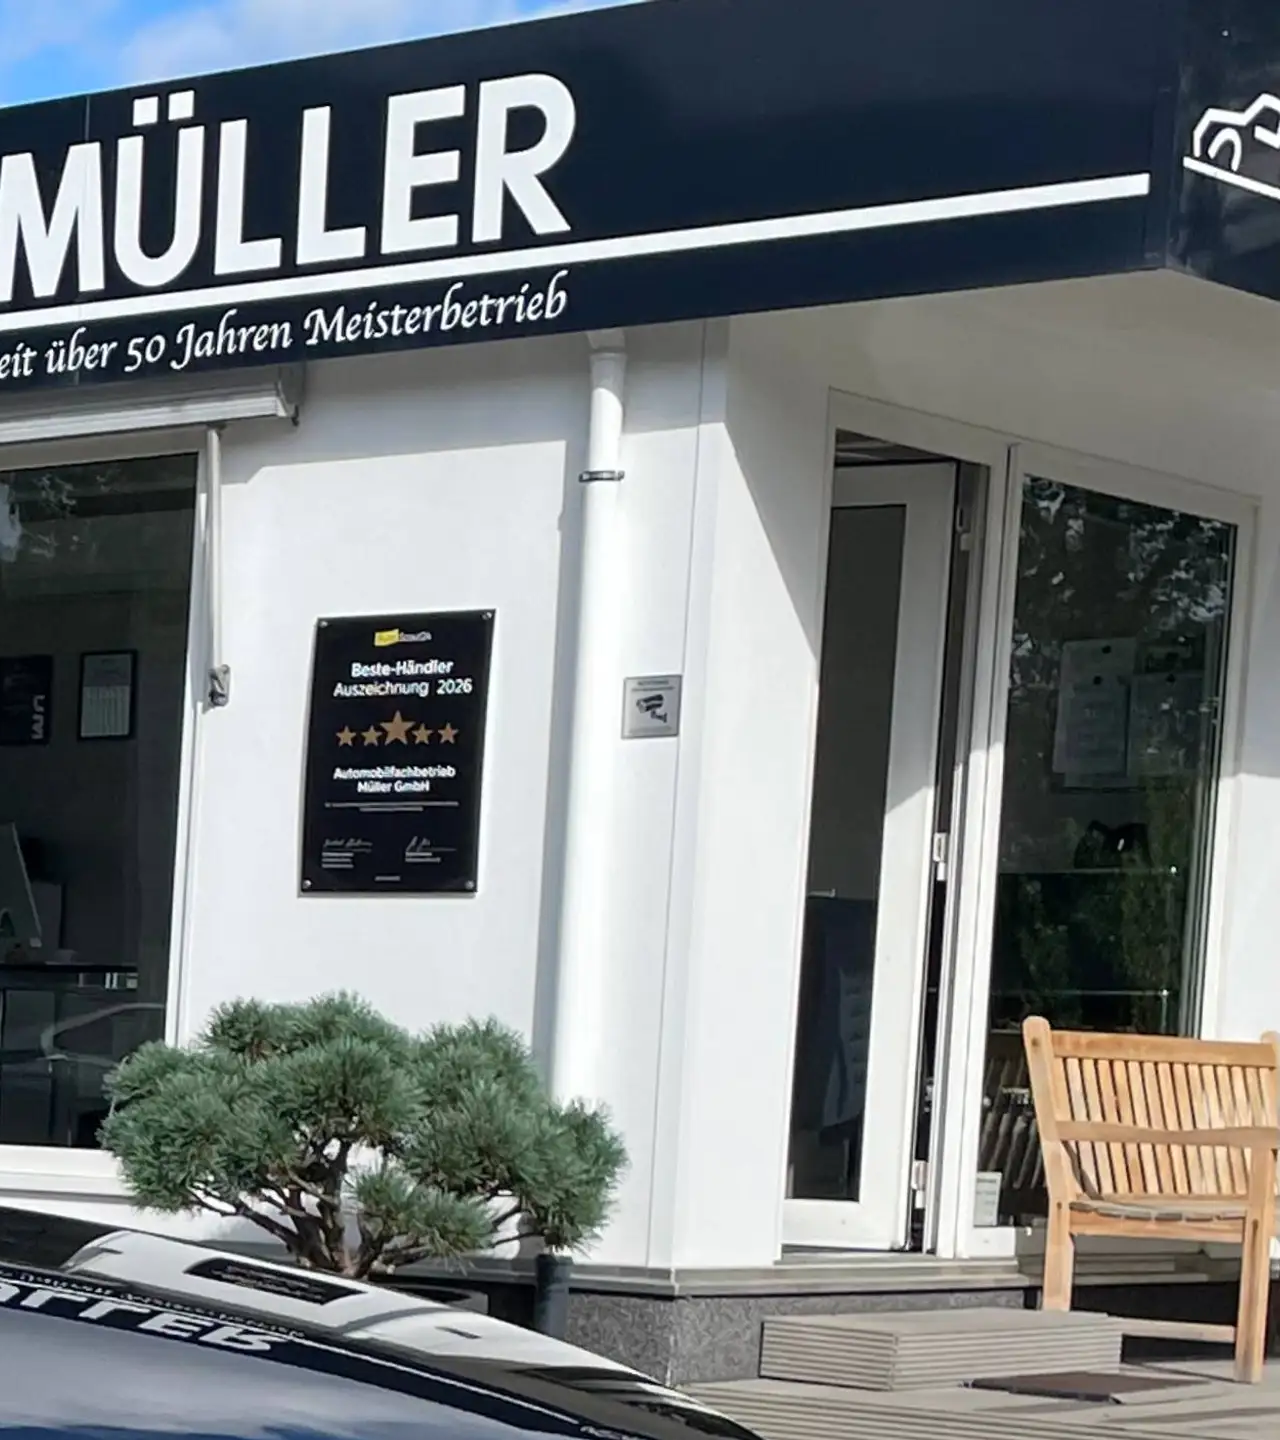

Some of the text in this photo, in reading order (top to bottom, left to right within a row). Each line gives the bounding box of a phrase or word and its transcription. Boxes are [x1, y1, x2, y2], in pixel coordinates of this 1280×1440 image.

[44, 327, 118, 374] über
[124, 336, 166, 372] 50
[169, 309, 292, 369] Jahren
[303, 270, 569, 346] Meisterbetrieb
[351, 659, 454, 678] Beste-Händler
[333, 678, 473, 698] Auszeichnung 2026
[333, 765, 457, 780] Automobilfachbetrieb
[357, 780, 430, 793] Müller GmbH
